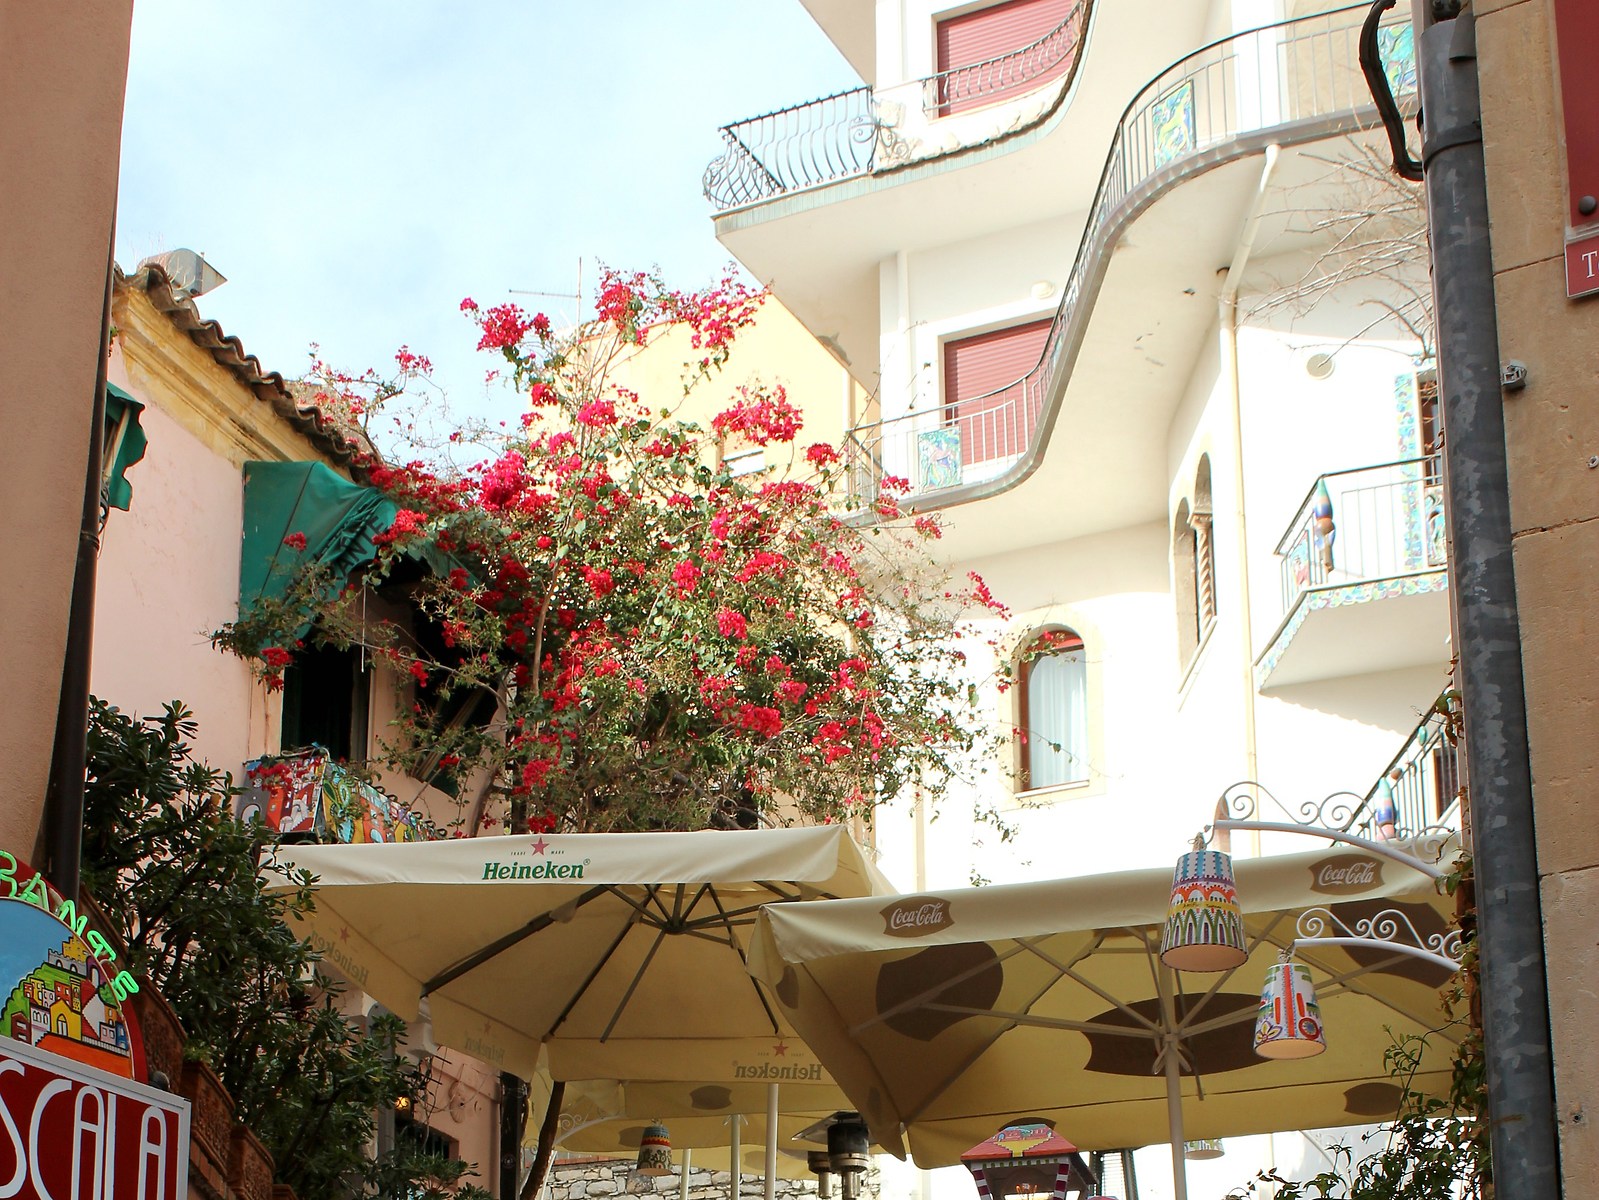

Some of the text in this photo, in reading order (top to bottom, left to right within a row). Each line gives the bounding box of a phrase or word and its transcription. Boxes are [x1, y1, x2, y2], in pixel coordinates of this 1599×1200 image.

[482, 859, 586, 880] Heineken
[1318, 862, 1376, 886] Coca-Cola
[890, 902, 944, 930] Coca-Cola
